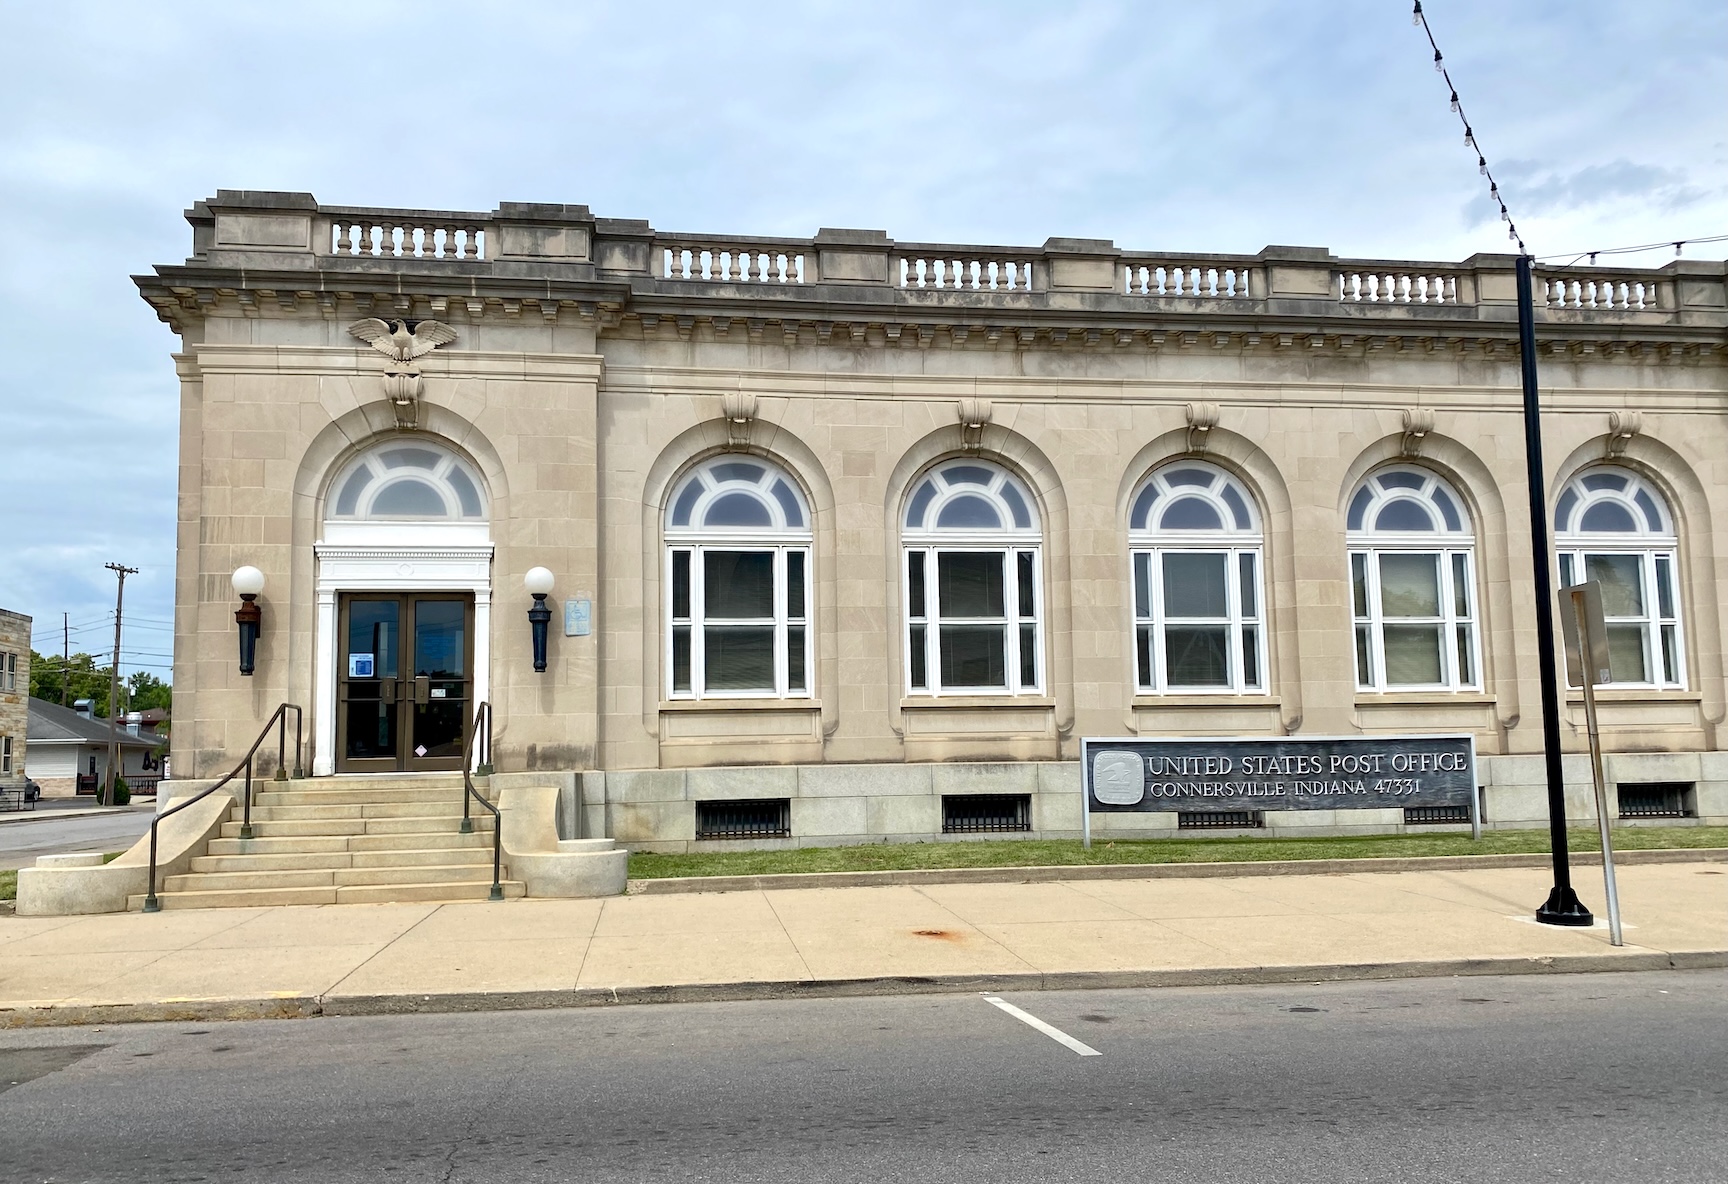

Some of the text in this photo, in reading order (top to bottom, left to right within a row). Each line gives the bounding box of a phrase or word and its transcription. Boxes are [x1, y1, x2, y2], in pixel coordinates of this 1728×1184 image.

[1148, 752, 1467, 775] UNITED STATES POST OFFICE
[1150, 778, 1421, 797] CONNERSVILLE INDIANA 47331
